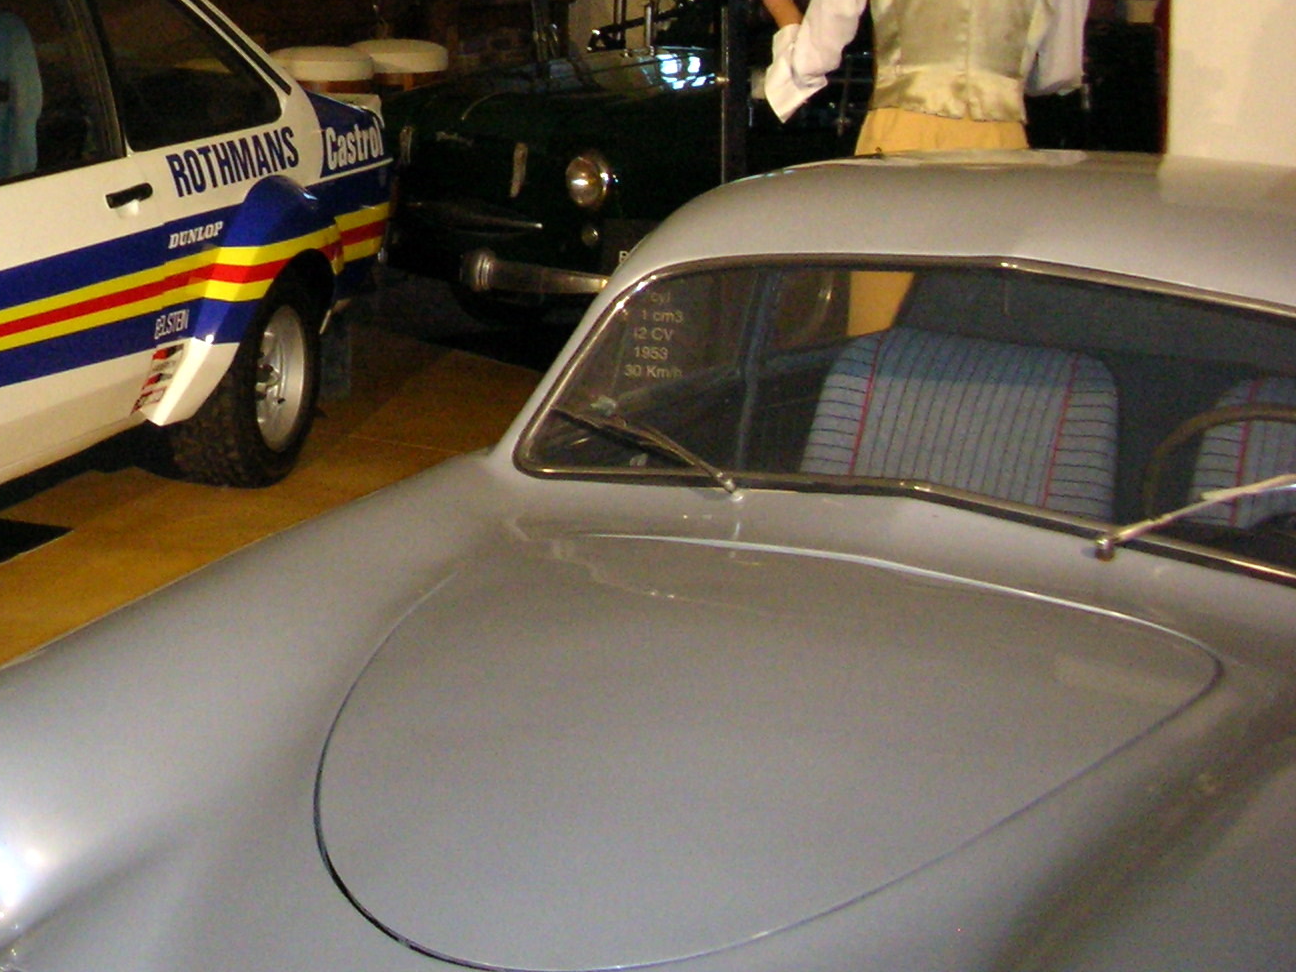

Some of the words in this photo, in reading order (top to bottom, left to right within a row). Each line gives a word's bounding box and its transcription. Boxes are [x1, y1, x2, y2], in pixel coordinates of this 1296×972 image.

[325, 115, 385, 171] Castrol
[165, 126, 299, 198] ROTHMANS
[168, 220, 224, 249] DUNLOP
[652, 310, 684, 323] cm3
[651, 328, 674, 341] CV
